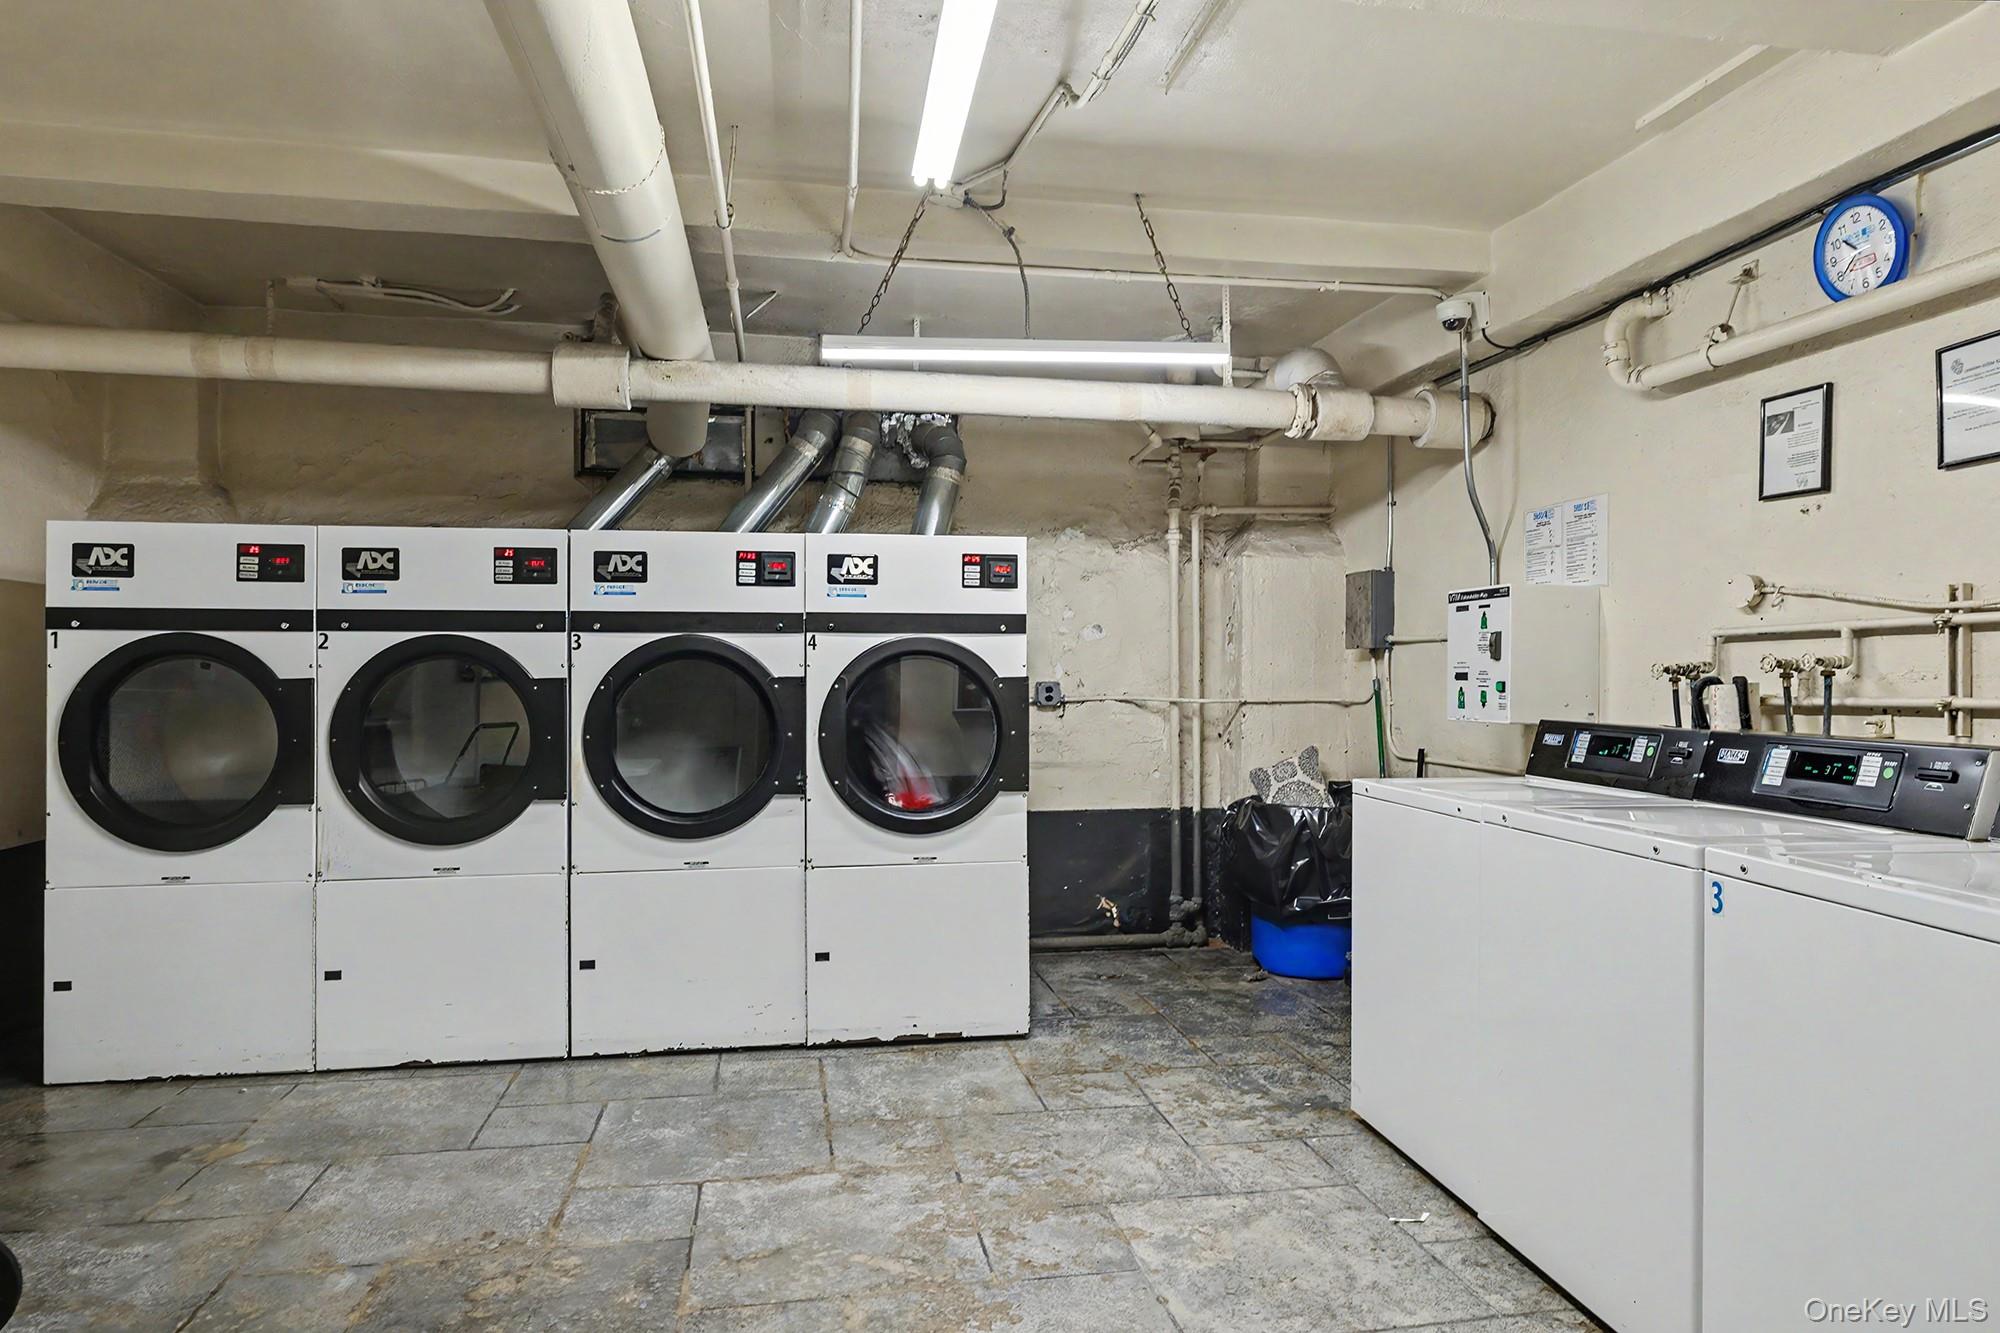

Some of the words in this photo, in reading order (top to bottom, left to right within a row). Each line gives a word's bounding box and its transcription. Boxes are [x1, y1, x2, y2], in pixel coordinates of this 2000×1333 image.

[1850, 212, 1861, 224] 12
[1867, 213, 1872, 222] 1
[1838, 224, 1847, 236] 11
[1879, 219, 1886, 231] 2
[1830, 238, 1841, 251] 10
[1830, 257, 1837, 268] 9
[1884, 253, 1890, 262] 4
[1837, 271, 1845, 282] 8
[1876, 267, 1882, 279] 5
[1862, 277, 1870, 289] 6
[88, 546, 128, 566] ADC
[356, 551, 394, 570] ADC
[607, 554, 643, 573] ADC
[841, 556, 874, 575] ADC
[50, 631, 58, 649] 1
[317, 633, 329, 650] 2
[572, 634, 582, 651] 3
[807, 634, 817, 651] 4
[1711, 881, 1723, 914] 3
